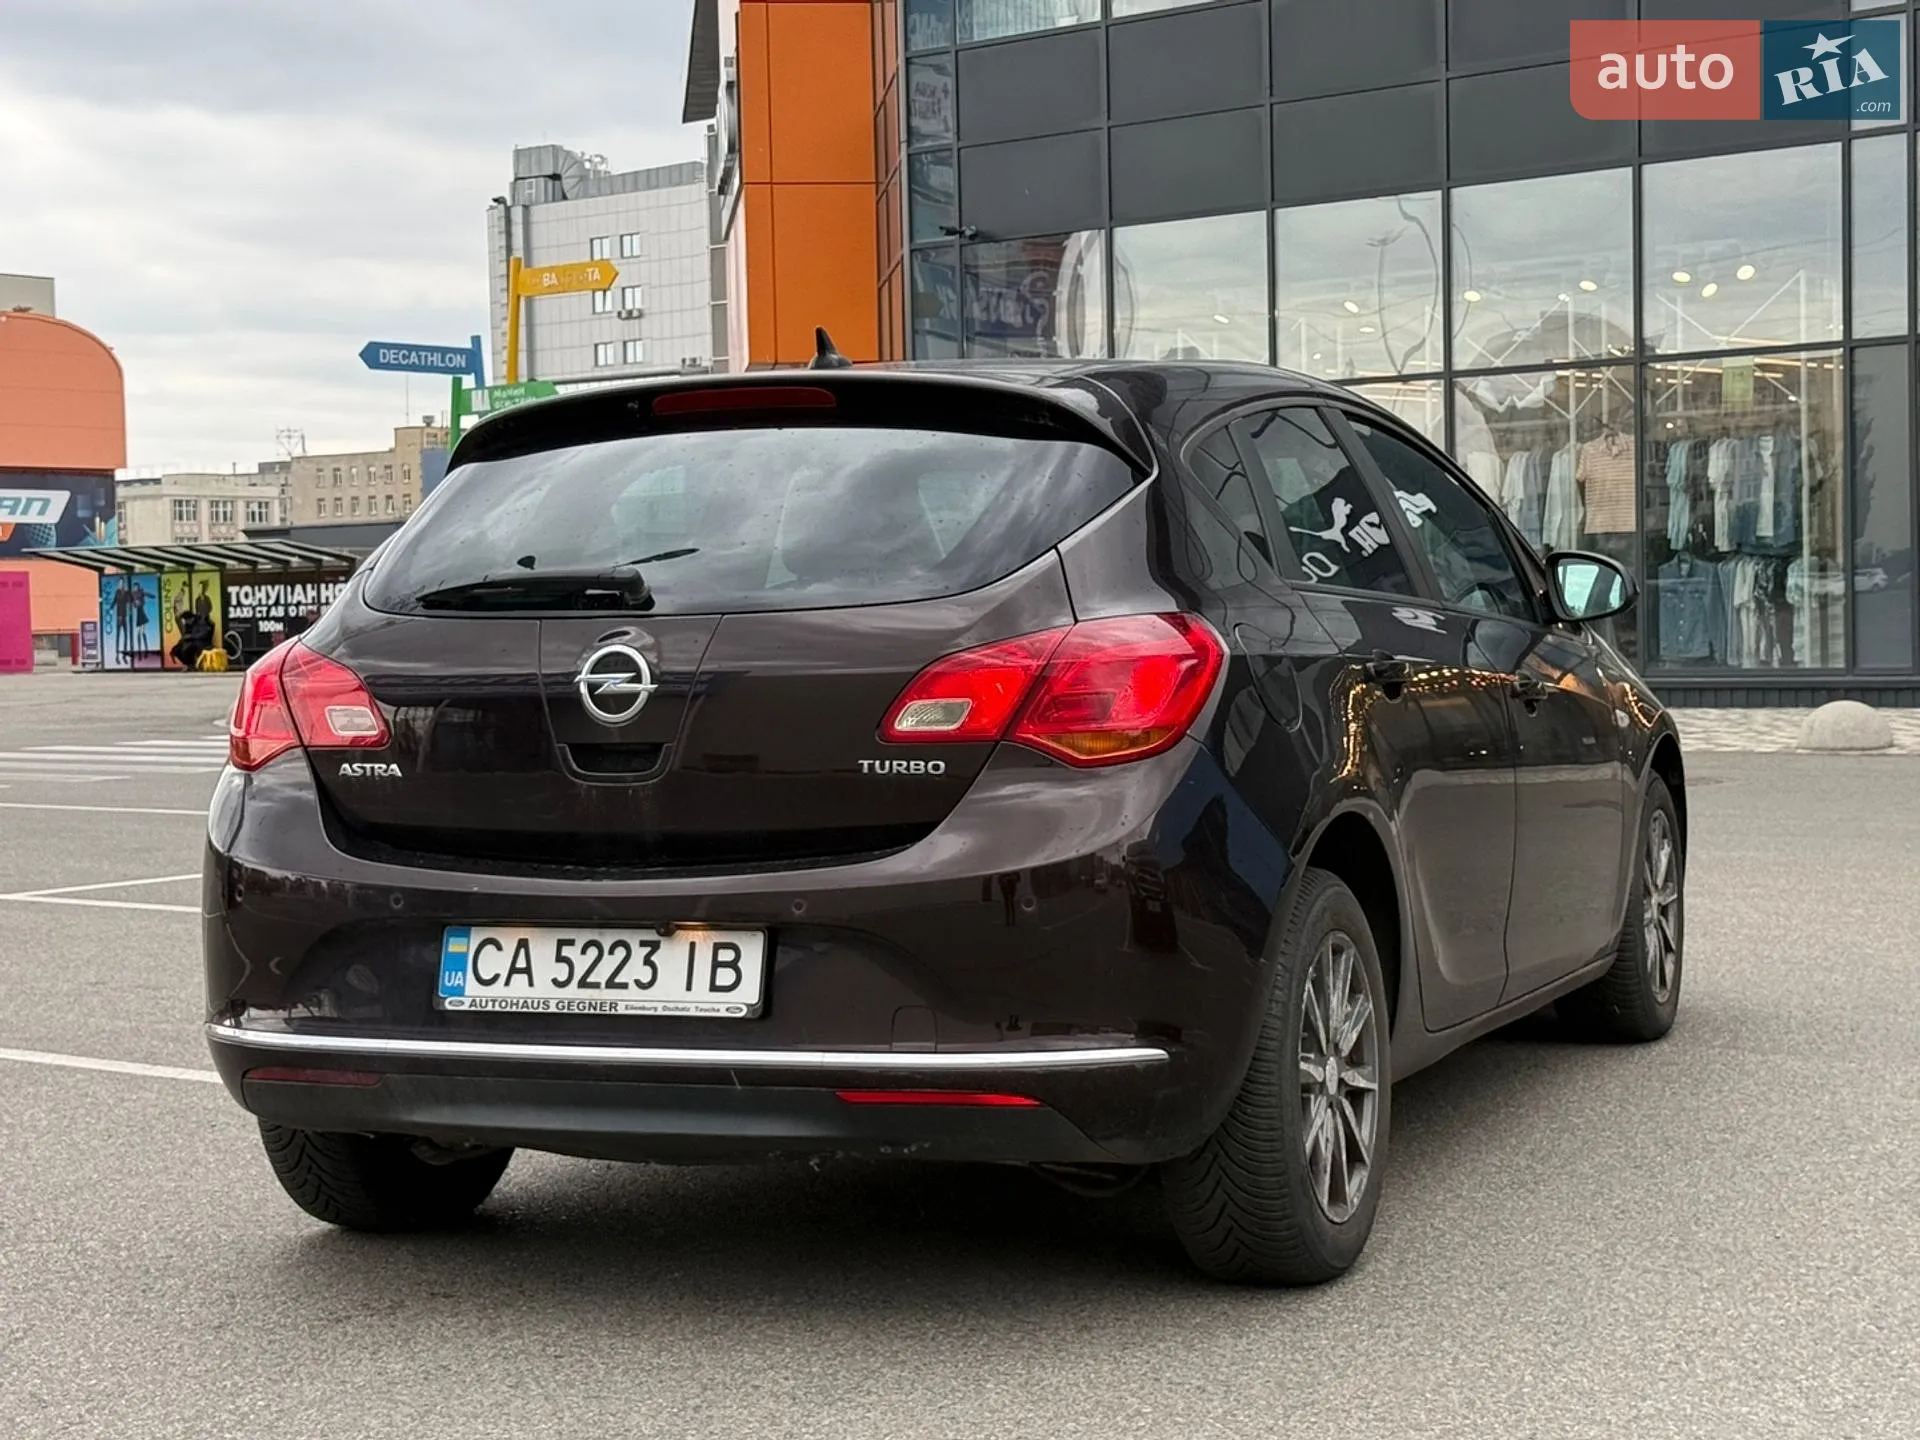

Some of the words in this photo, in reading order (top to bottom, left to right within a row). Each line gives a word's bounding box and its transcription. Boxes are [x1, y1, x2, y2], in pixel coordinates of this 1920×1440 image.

[379, 348, 467, 368] DECATHLON
[338, 763, 403, 777] ASTRA
[857, 760, 946, 775] TURBO
[472, 938, 535, 988] CA
[550, 939, 661, 990] 5223
[685, 941, 743, 993] IB
[444, 971, 464, 987] UA
[469, 998, 551, 1011] AUTOHAUS
[555, 1000, 619, 1013] GEGNER
